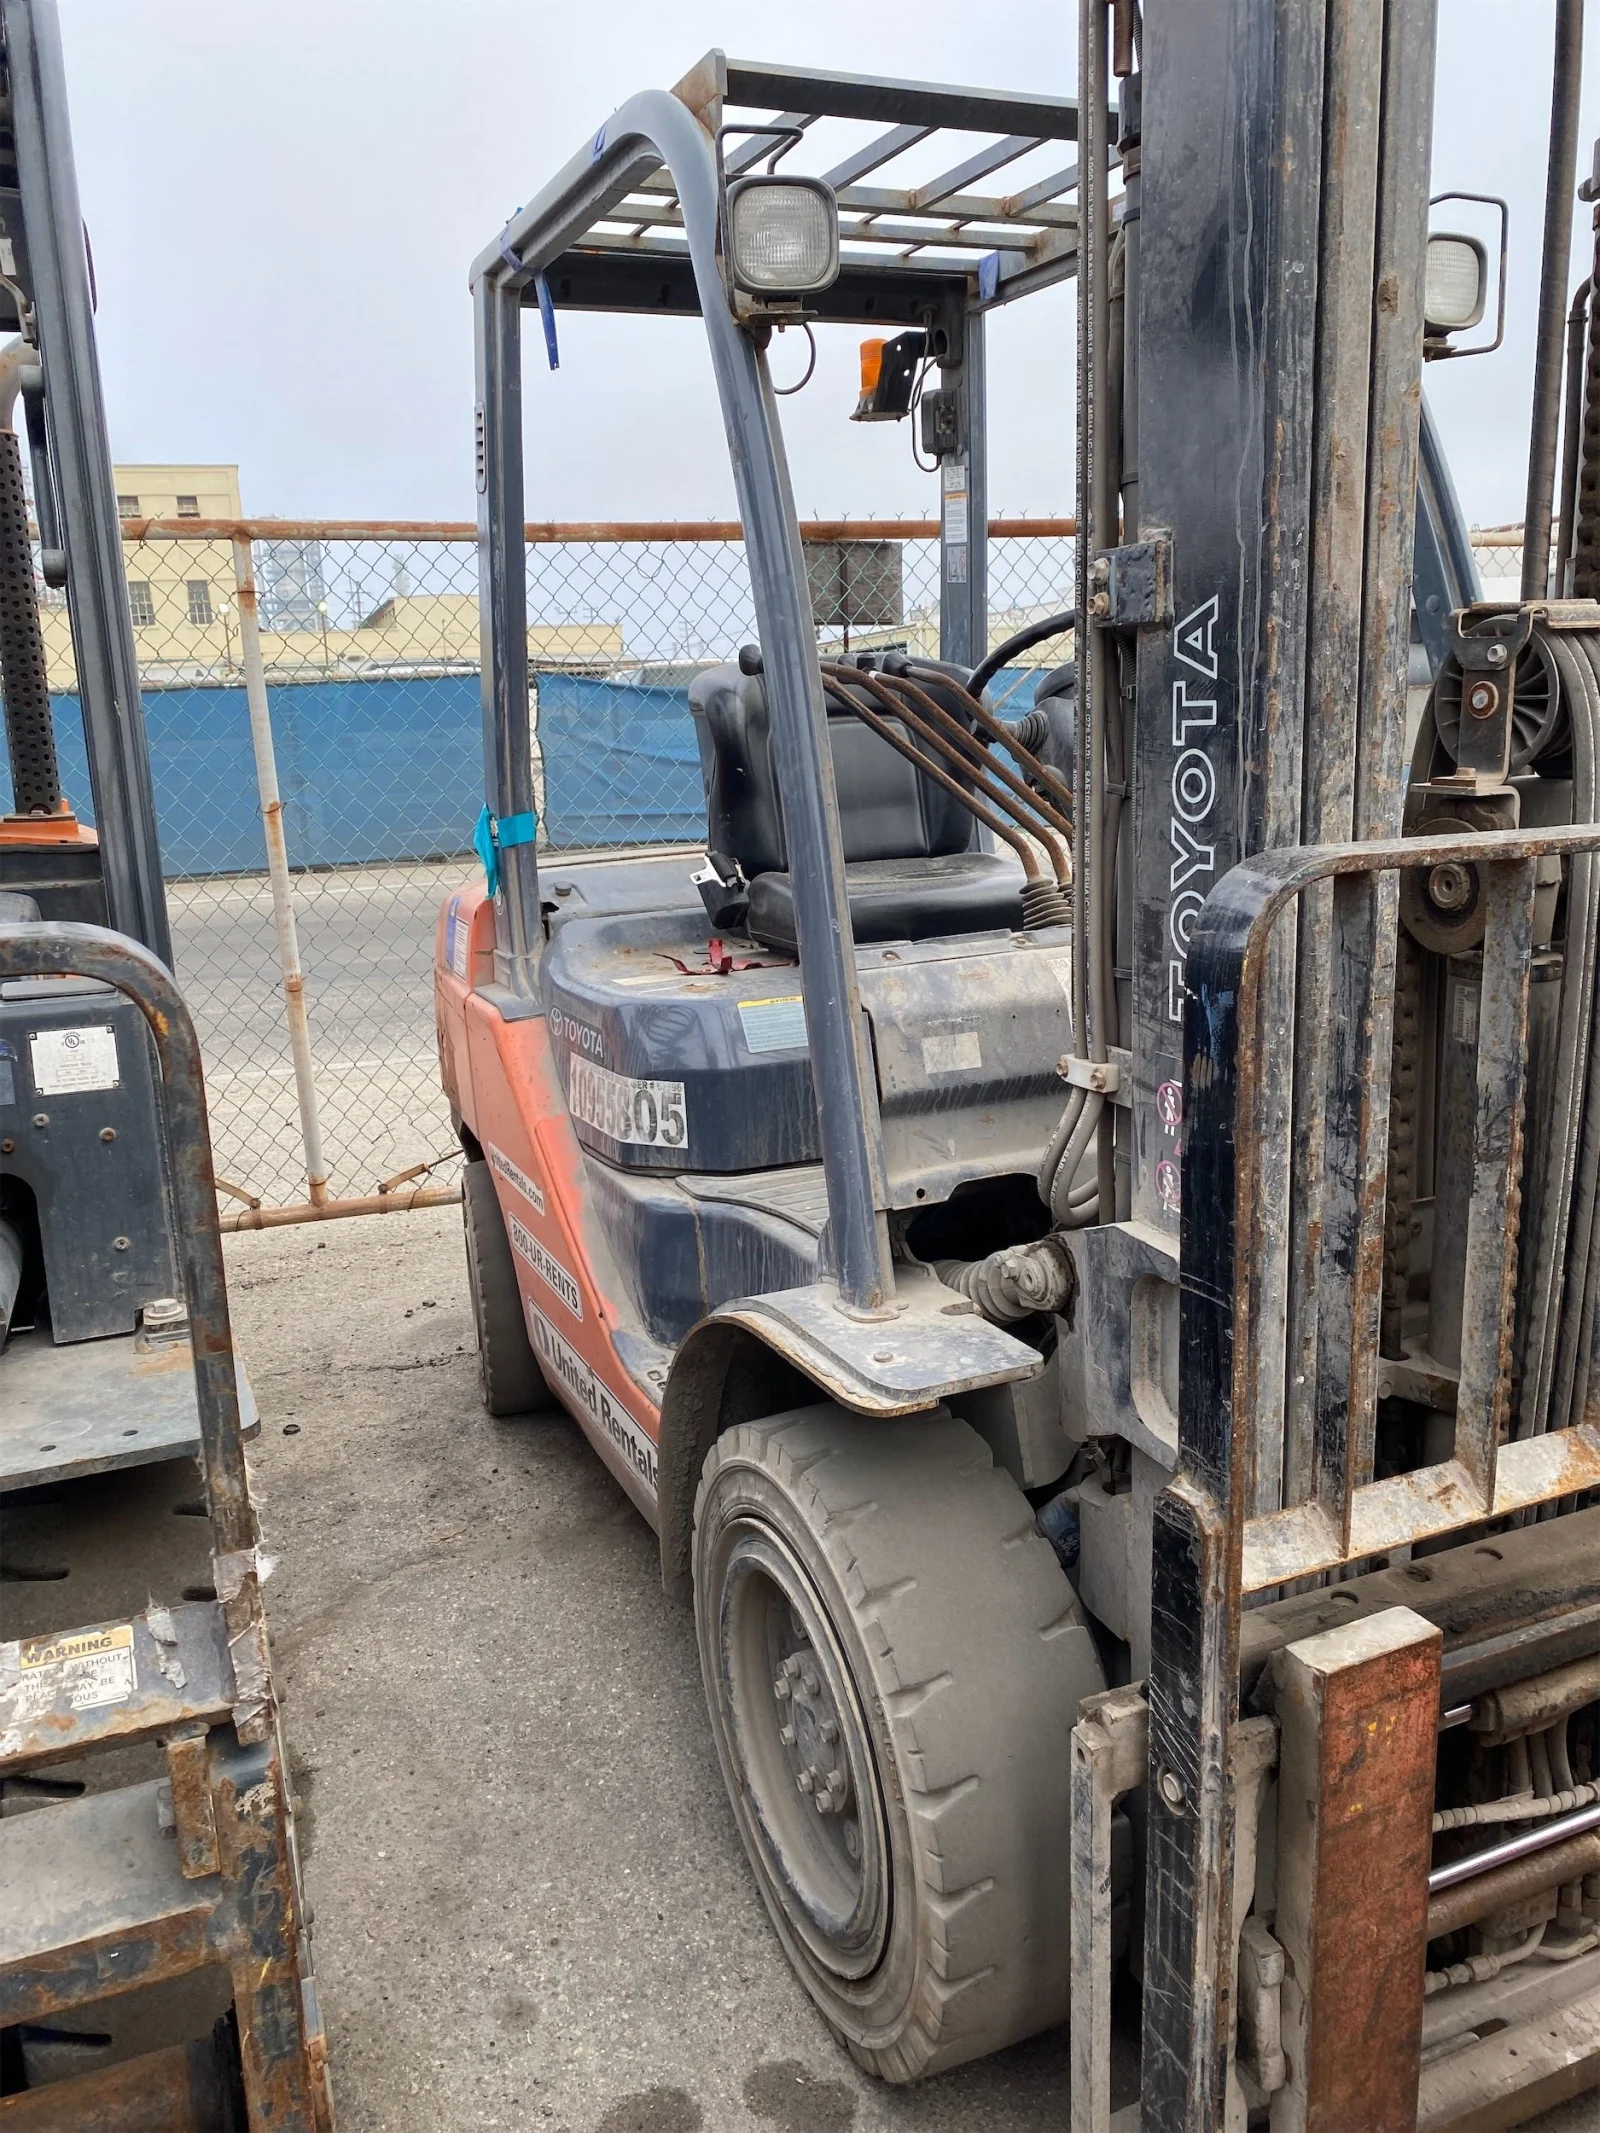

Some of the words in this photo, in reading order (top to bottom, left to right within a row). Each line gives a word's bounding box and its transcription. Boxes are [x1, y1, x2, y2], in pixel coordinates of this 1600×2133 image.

[563, 1016, 604, 1058] TOYOTA
[512, 1223, 579, 1310] 800-UR-RENTS
[551, 1336, 598, 1416] United
[600, 1394, 659, 1489] Rentals
[26, 1636, 113, 1664] WARNING
[100, 1676, 116, 1687] BE
